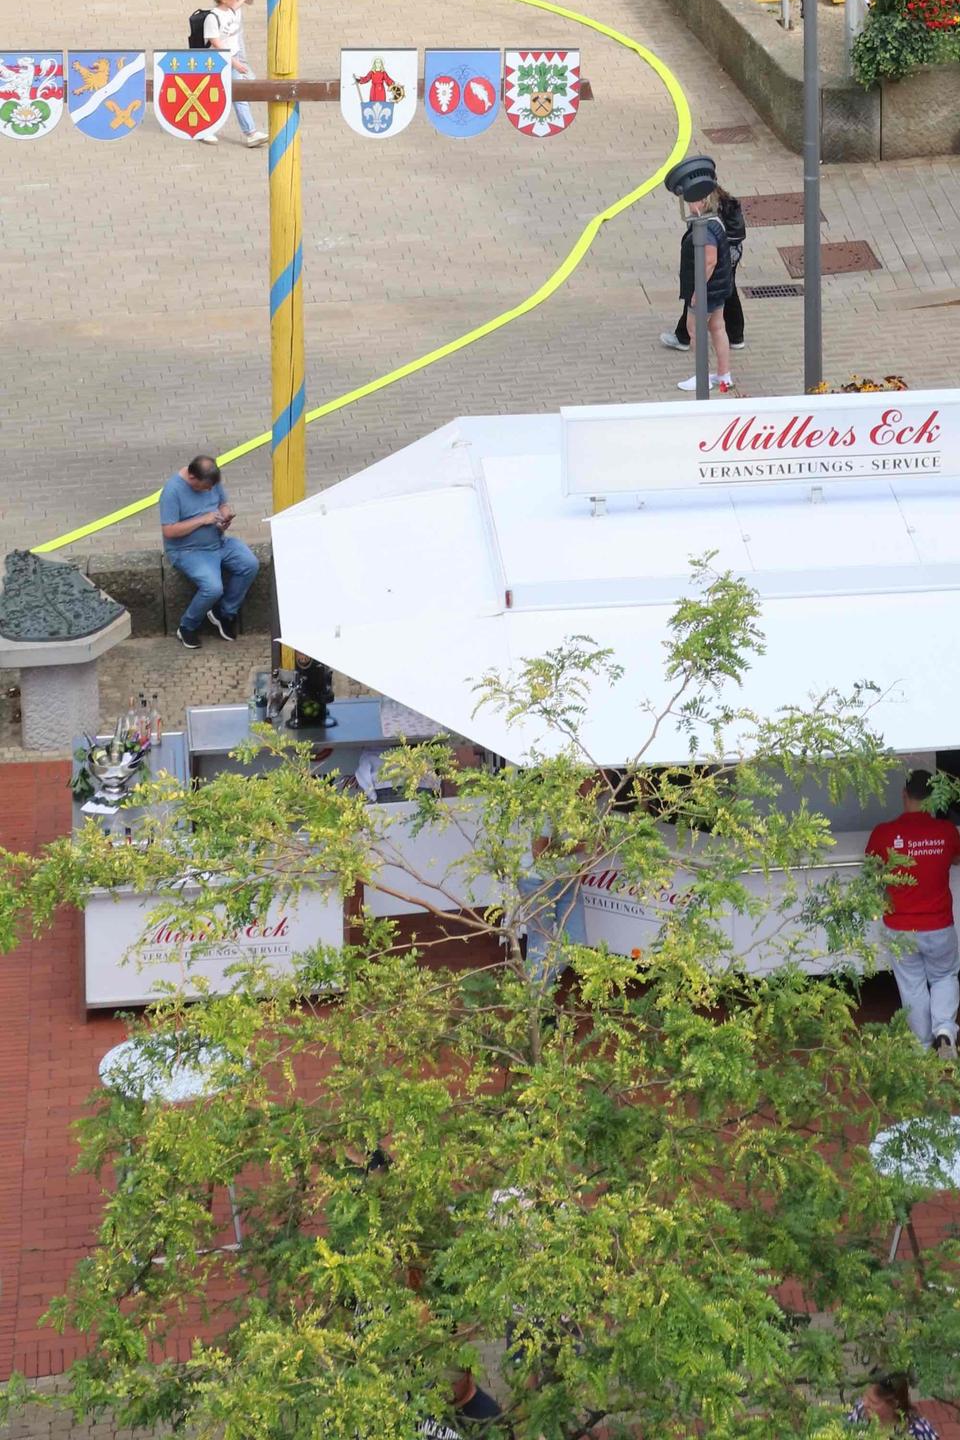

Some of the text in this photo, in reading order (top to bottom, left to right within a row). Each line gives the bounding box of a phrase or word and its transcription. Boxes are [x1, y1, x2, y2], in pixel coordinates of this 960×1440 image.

[699, 409, 940, 452] Müllers Eck
[699, 461, 853, 478] VERANSTALTUNGS
[872, 456, 940, 471] SERVICE
[908, 839, 945, 848] Sparkasse
[908, 848, 944, 857] Hannover
